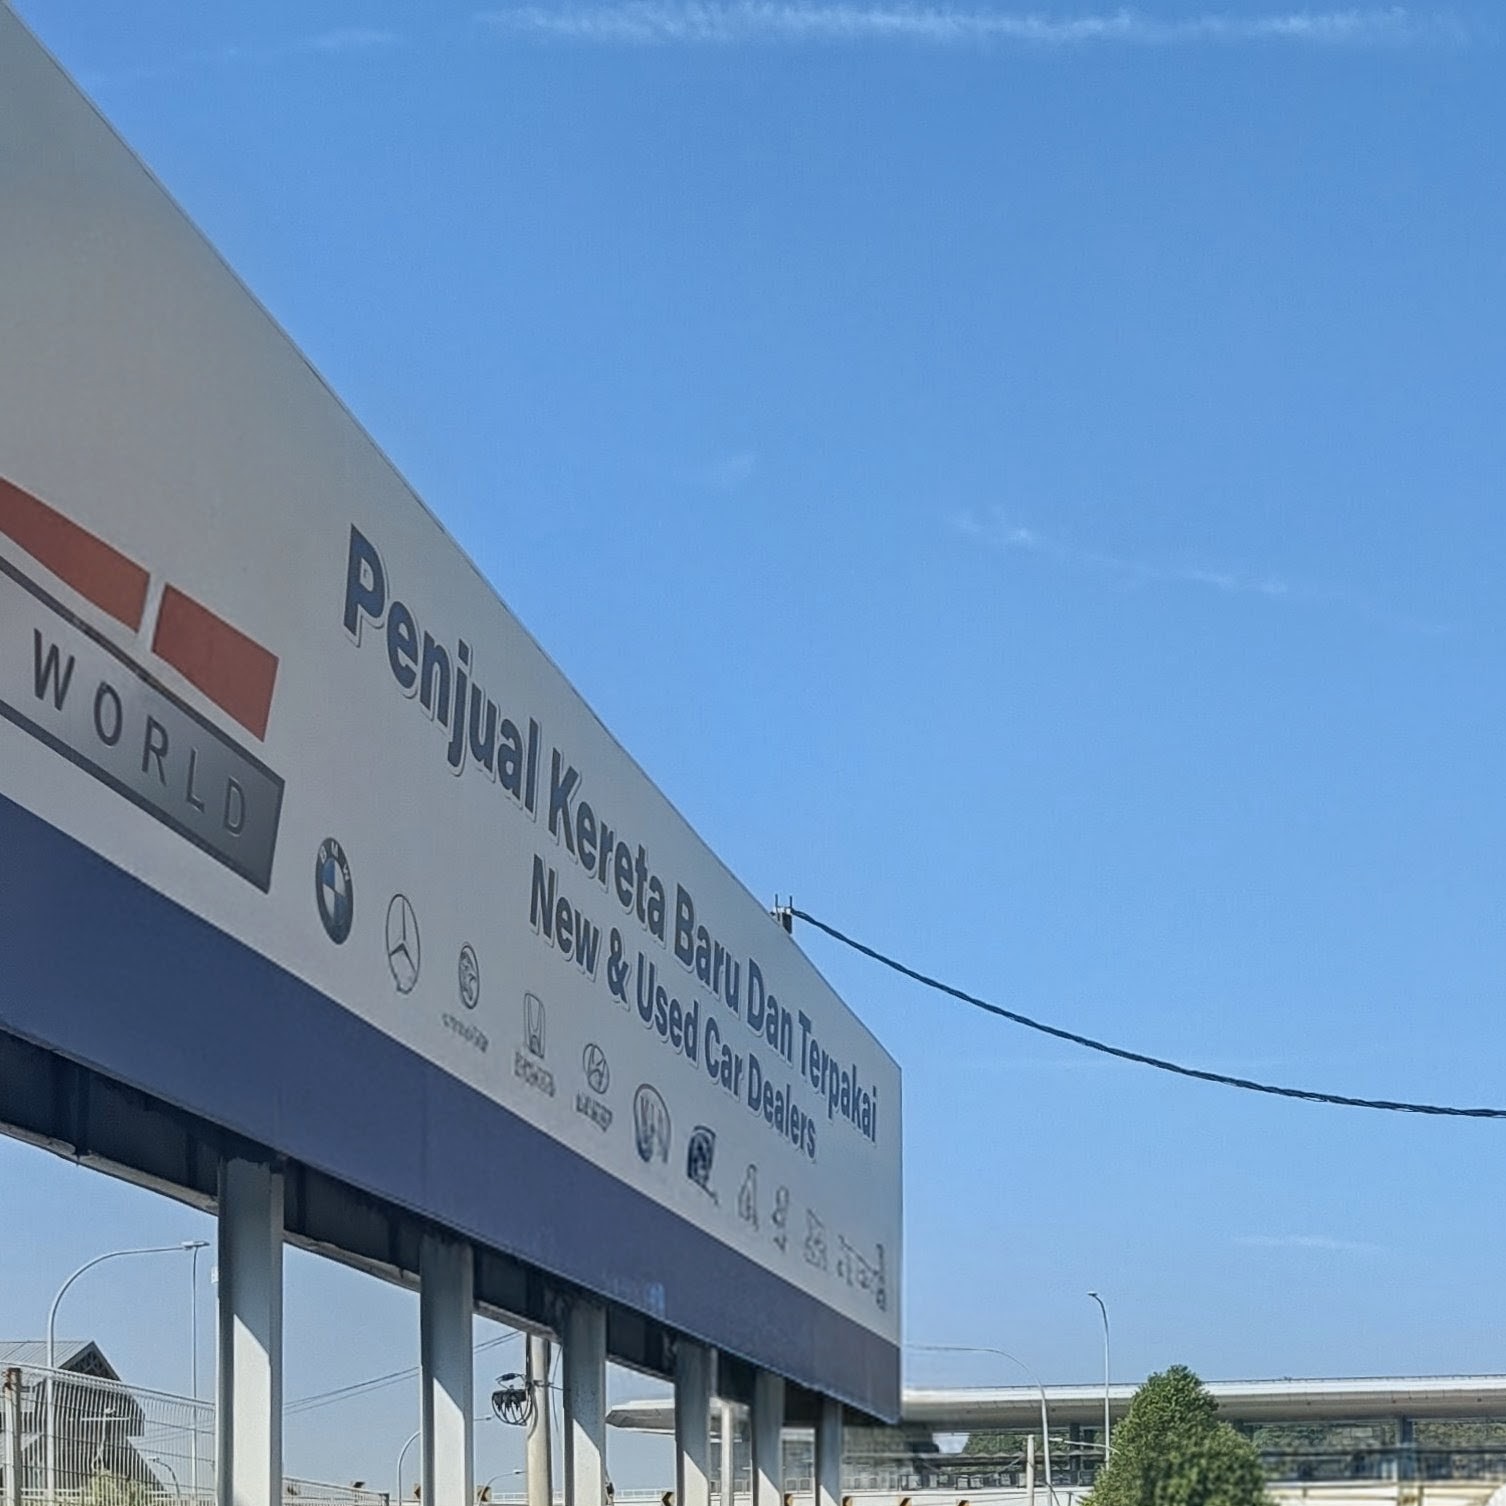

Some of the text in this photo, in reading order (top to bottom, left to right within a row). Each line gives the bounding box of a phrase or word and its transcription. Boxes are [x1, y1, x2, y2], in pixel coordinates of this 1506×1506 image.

[34, 628, 246, 837] WORLD
[343, 523, 540, 814] Penjual
[548, 747, 665, 942] Kereta
[674, 882, 739, 1011] Baru
[747, 958, 793, 1063] Dan
[798, 1009, 878, 1142] Terpakai
[530, 854, 600, 976] New
[606, 928, 631, 1002] &
[637, 952, 700, 1062] Used
[704, 1018, 744, 1097] Car
[747, 1053, 816, 1159] Dealers
